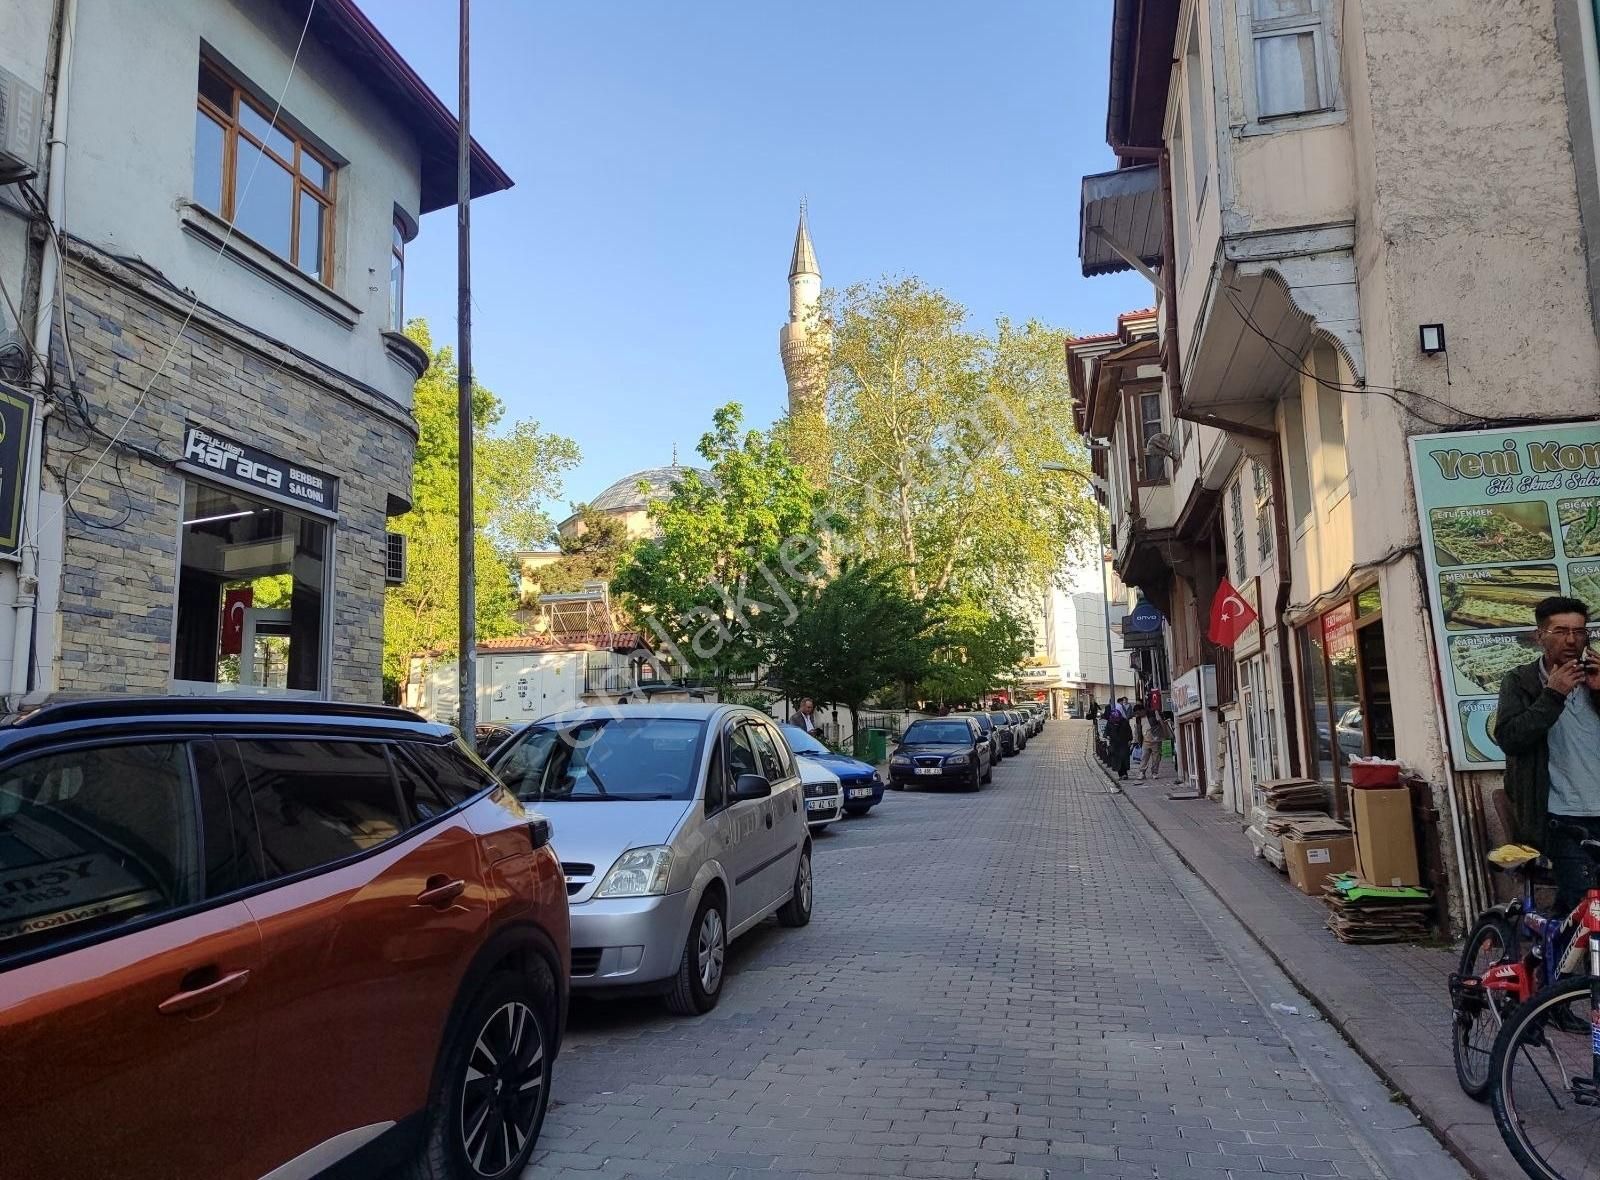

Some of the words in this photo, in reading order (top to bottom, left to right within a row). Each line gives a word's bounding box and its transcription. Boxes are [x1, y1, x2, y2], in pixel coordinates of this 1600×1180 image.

[1429, 438, 1523, 481] Yeni
[289, 467, 324, 490] BERBER
[1486, 476, 1514, 497] Etli
[1516, 472, 1563, 495] Ekmek
[288, 482, 324, 504] SALONU
[1460, 508, 1493, 518] EKMEK
[1445, 571, 1492, 582] MEVLANA
[1494, 634, 1518, 645] PİDE
